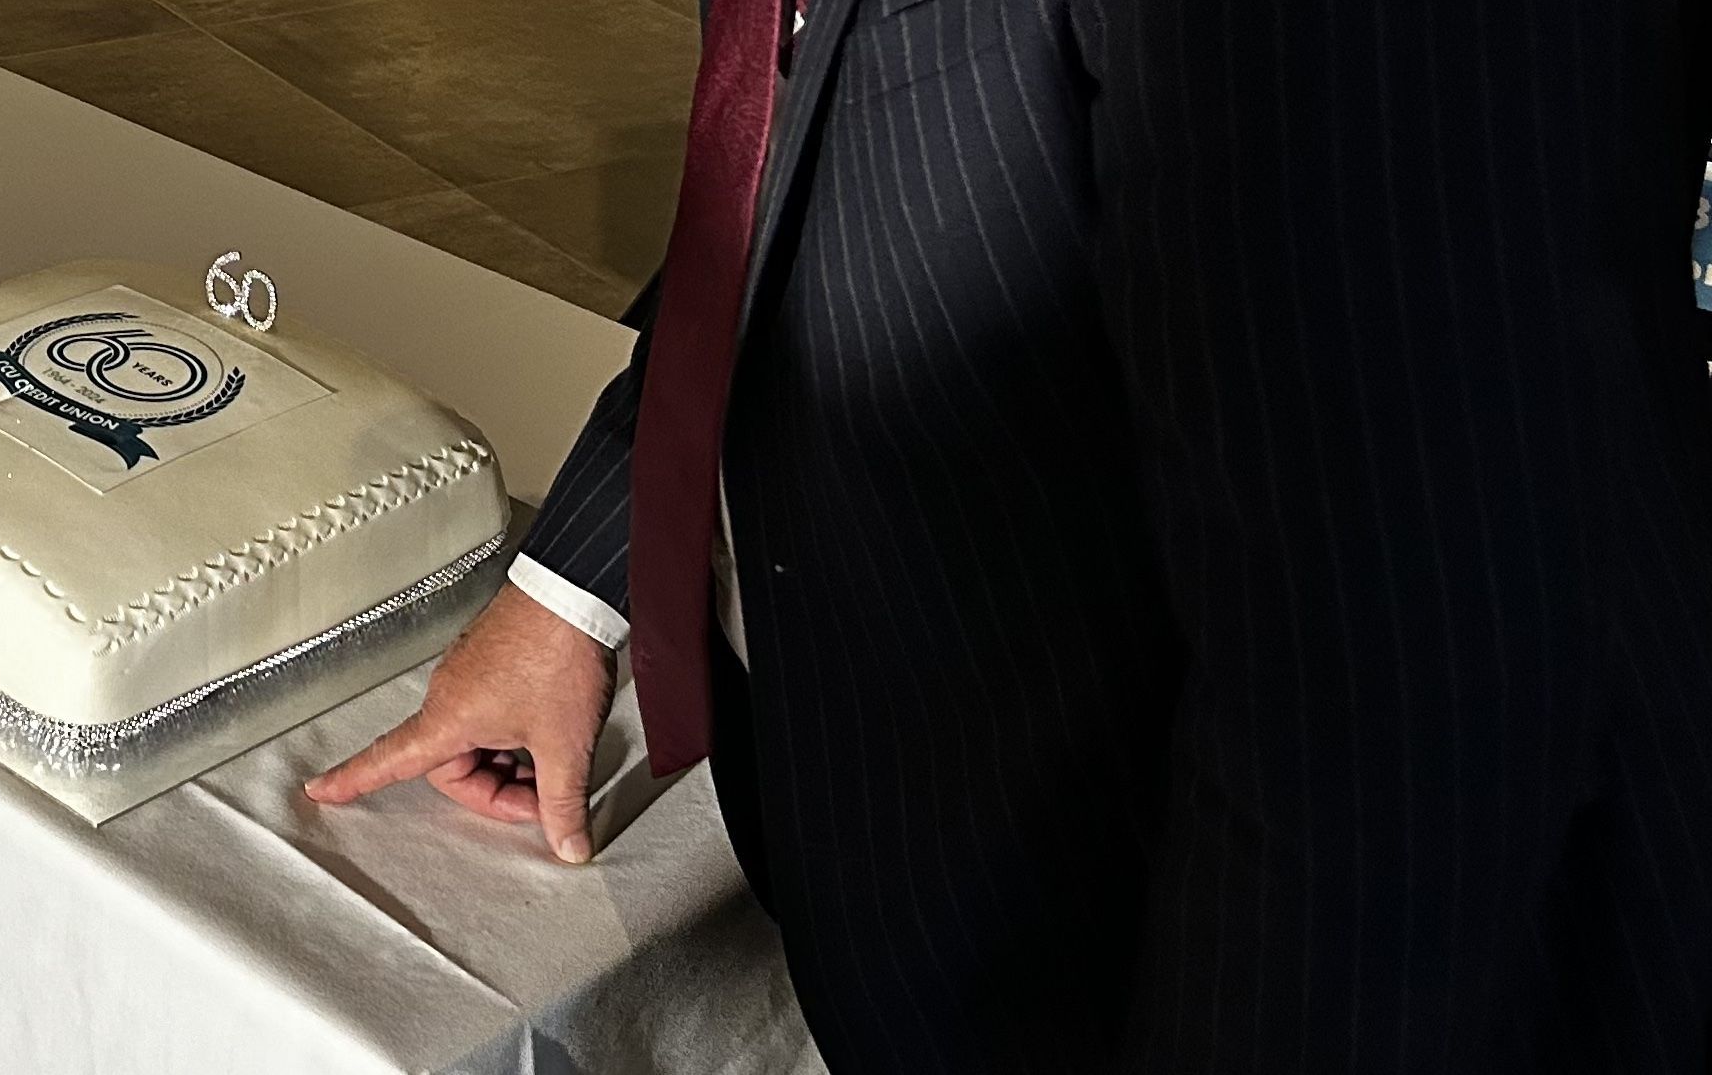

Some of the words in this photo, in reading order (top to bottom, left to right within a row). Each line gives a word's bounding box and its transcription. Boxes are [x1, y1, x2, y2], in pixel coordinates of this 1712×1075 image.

[205, 251, 278, 331] 60
[41, 367, 71, 387] 1964
[132, 362, 174, 387] YEARS
[14, 378, 61, 406] CREDIT
[59, 403, 120, 431] UNION
